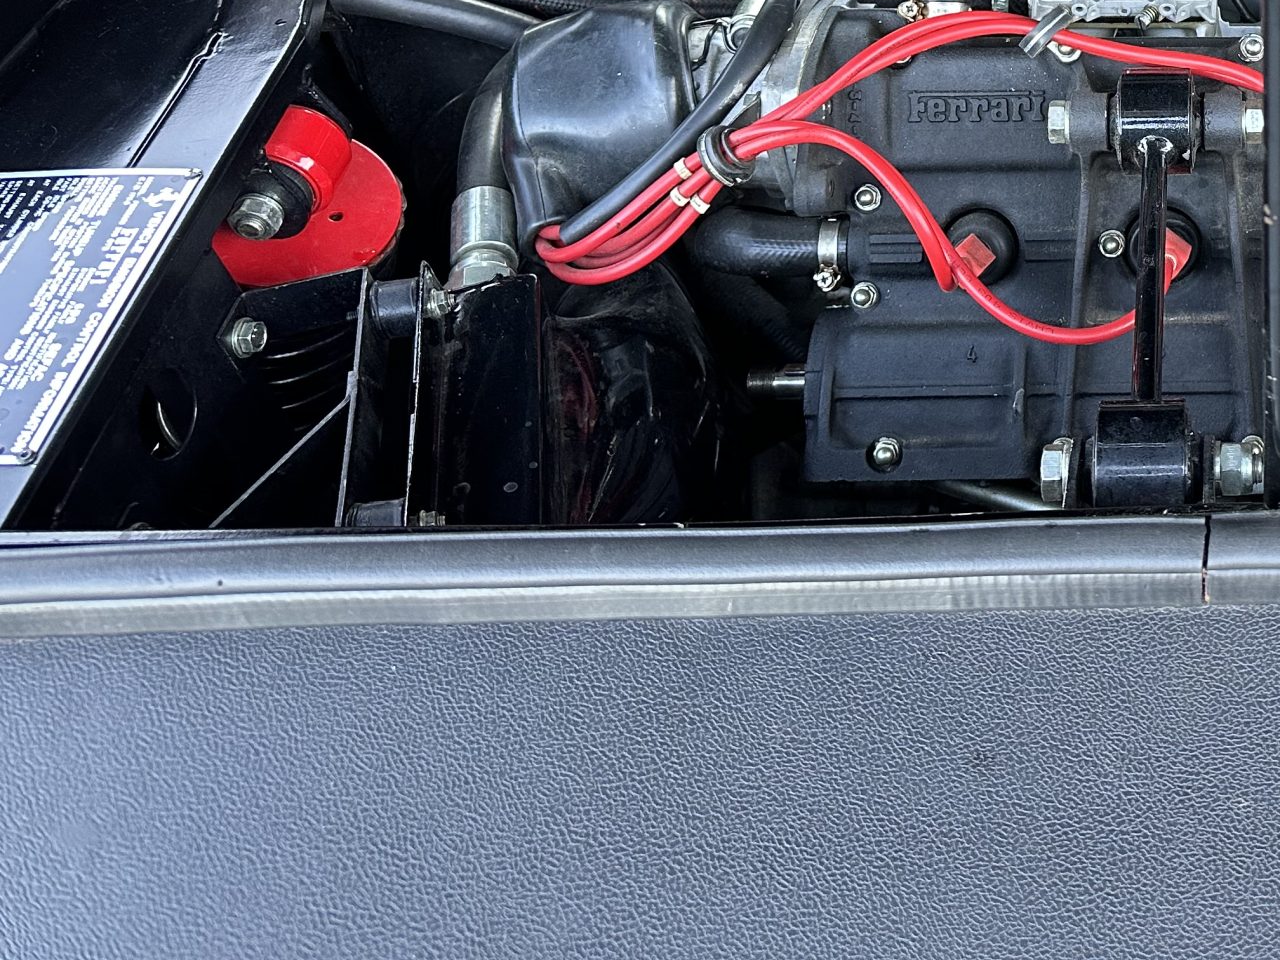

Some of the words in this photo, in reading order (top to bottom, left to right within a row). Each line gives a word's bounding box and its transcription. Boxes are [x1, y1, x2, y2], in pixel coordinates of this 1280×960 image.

[908, 91, 1046, 123] Ferrari
[128, 210, 167, 253] VEHICLE
[95, 257, 138, 307] EMISSION
[59, 312, 104, 366] CONTROL
[9, 372, 69, 452] INFORMATION
